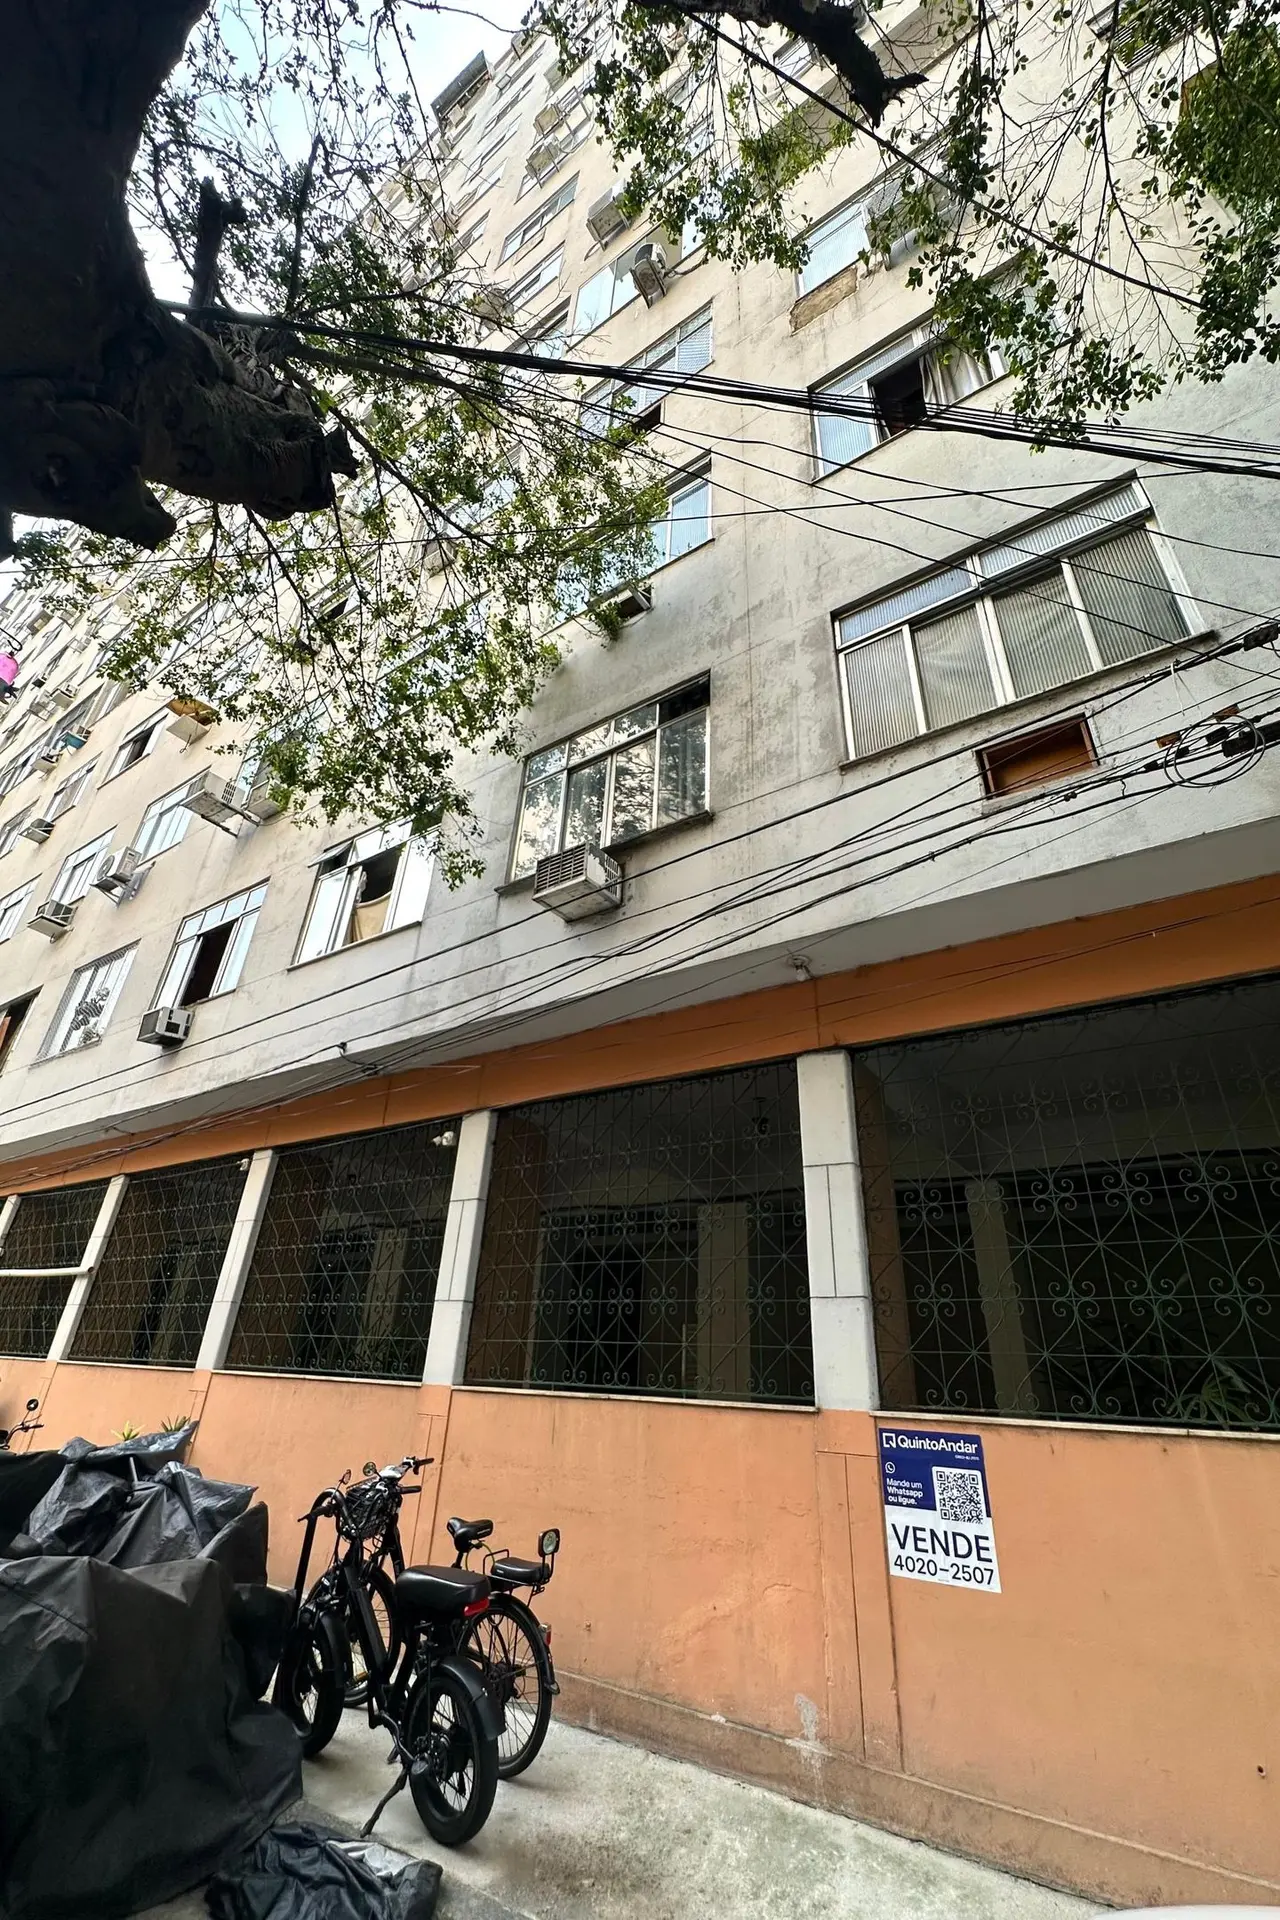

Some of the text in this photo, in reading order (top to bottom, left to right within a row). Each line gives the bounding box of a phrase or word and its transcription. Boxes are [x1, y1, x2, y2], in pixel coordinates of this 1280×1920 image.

[897, 1435, 978, 1454] QuintoAndar
[886, 1478, 923, 1489] Mande um
[887, 1486, 923, 1498] Whatsapp
[898, 1496, 918, 1505] ligue.
[891, 1523, 993, 1563] VENDE
[894, 1554, 994, 1585] 4020-2507
